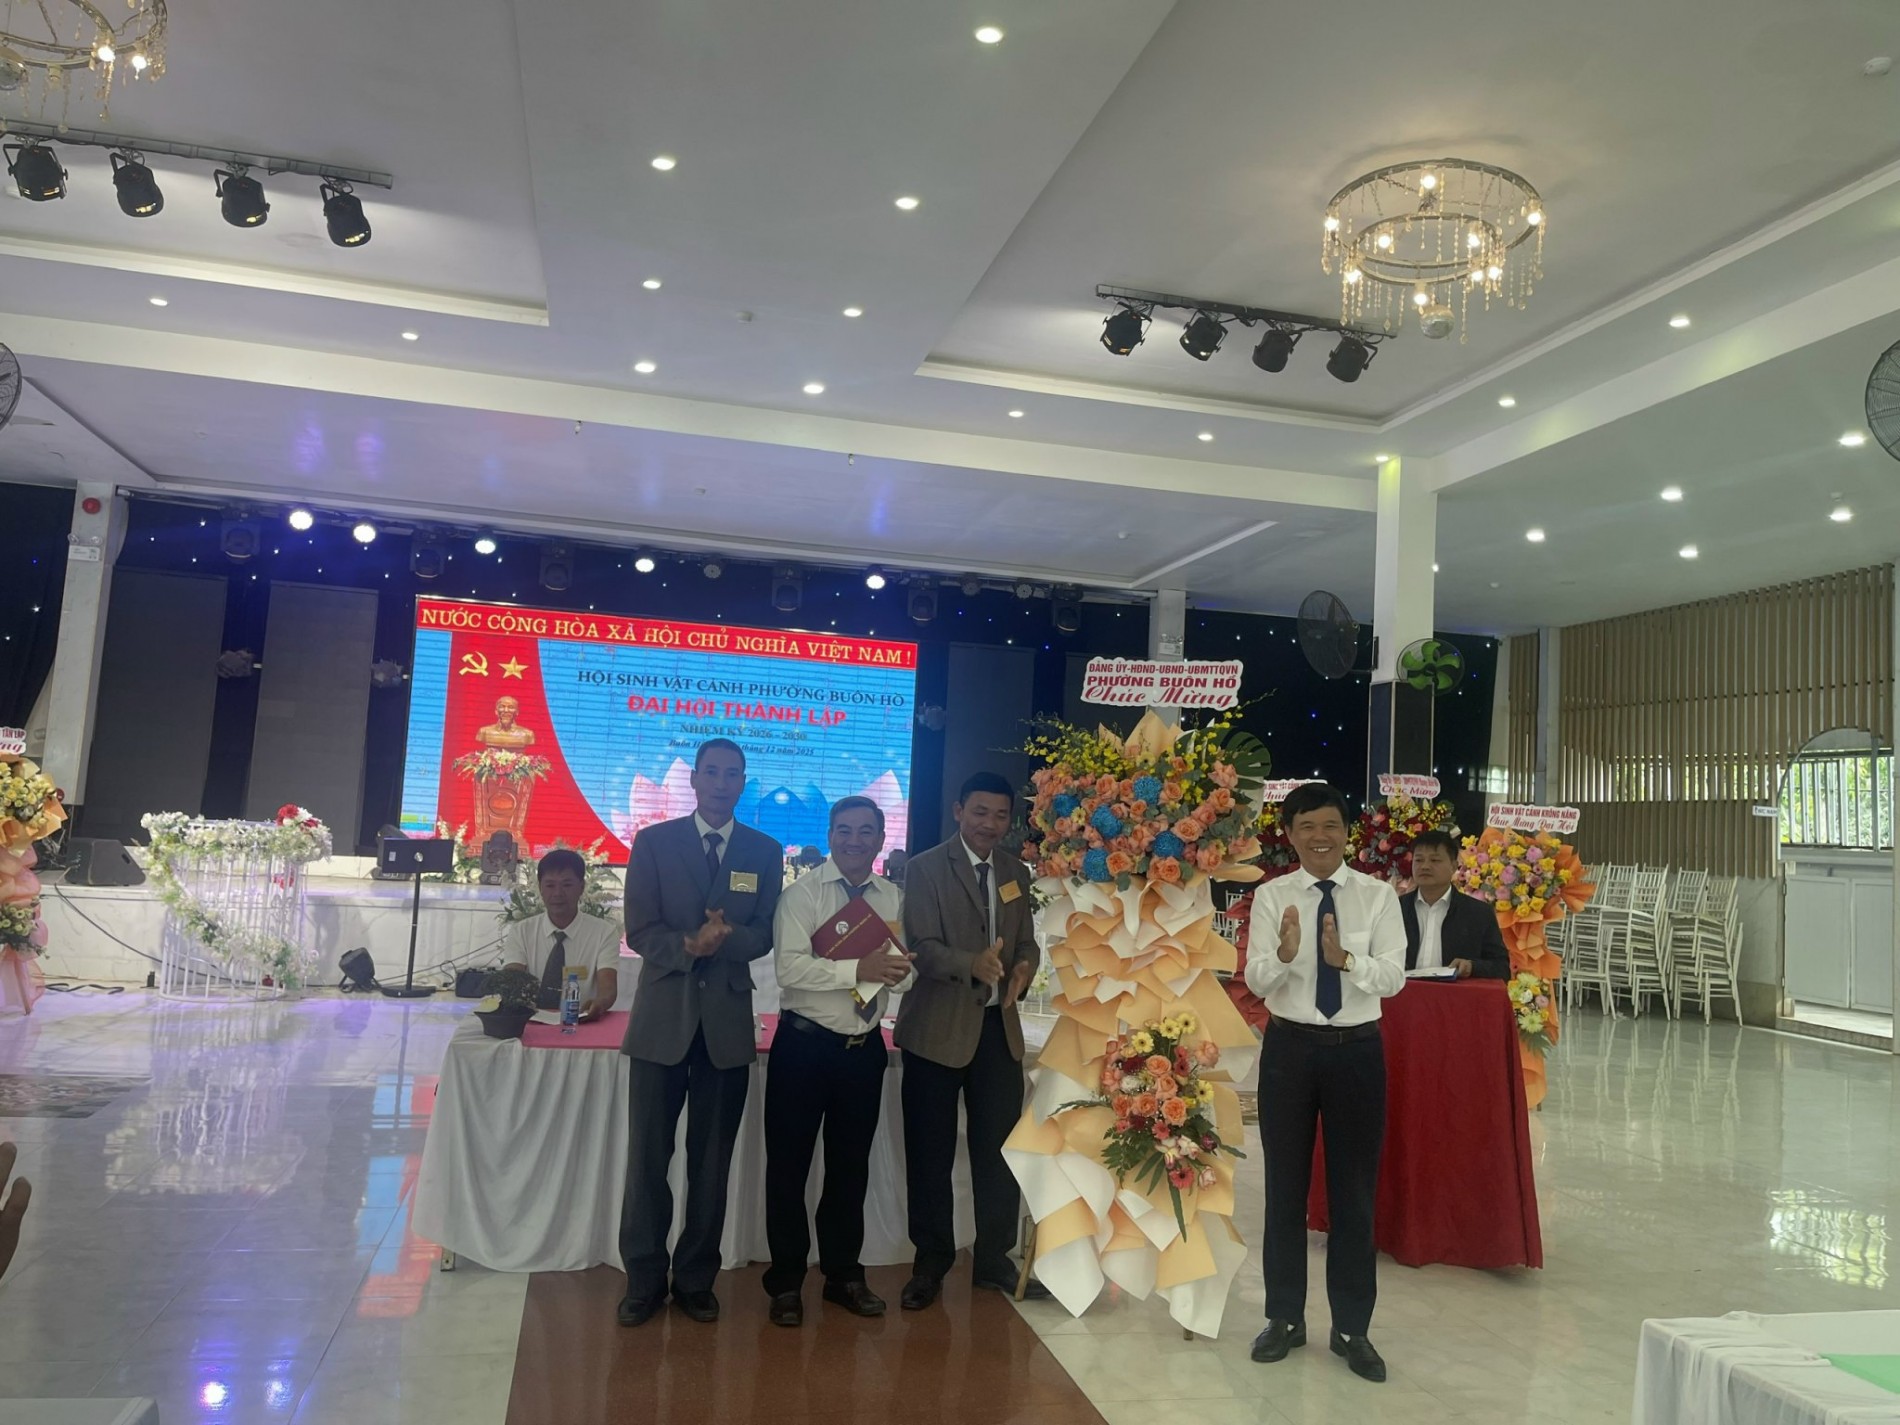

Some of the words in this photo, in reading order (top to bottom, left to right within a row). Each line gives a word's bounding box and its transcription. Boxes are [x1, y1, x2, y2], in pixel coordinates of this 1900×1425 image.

[421, 607, 482, 628] NƯỚC
[487, 611, 548, 635] CỘNG
[554, 617, 599, 637] HÒA
[643, 624, 682, 648] HỘI
[687, 628, 729, 648] CHỦ
[735, 636, 801, 655] NGHĨA
[807, 640, 852, 663] VIỆT
[857, 647, 902, 664] NAM
[1089, 661, 1113, 673] ĐẢNG
[578, 670, 612, 686] HỘI
[617, 673, 658, 687] SINH
[663, 675, 693, 692] VẬT
[697, 678, 744, 695] CẢNH
[749, 683, 825, 701] PHƯỜNG
[829, 688, 876, 705] BUÔN
[880, 692, 905, 707] HỒ
[1087, 675, 1154, 687] PHƯỜNG
[1159, 675, 1207, 688] BUÔN
[1085, 686, 1146, 703] Chúc
[1153, 687, 1232, 708] Mừng
[628, 695, 668, 716] ĐẠI
[675, 698, 715, 720] HỘI
[722, 700, 802, 722] THÀNH
[808, 704, 847, 729] LẬP
